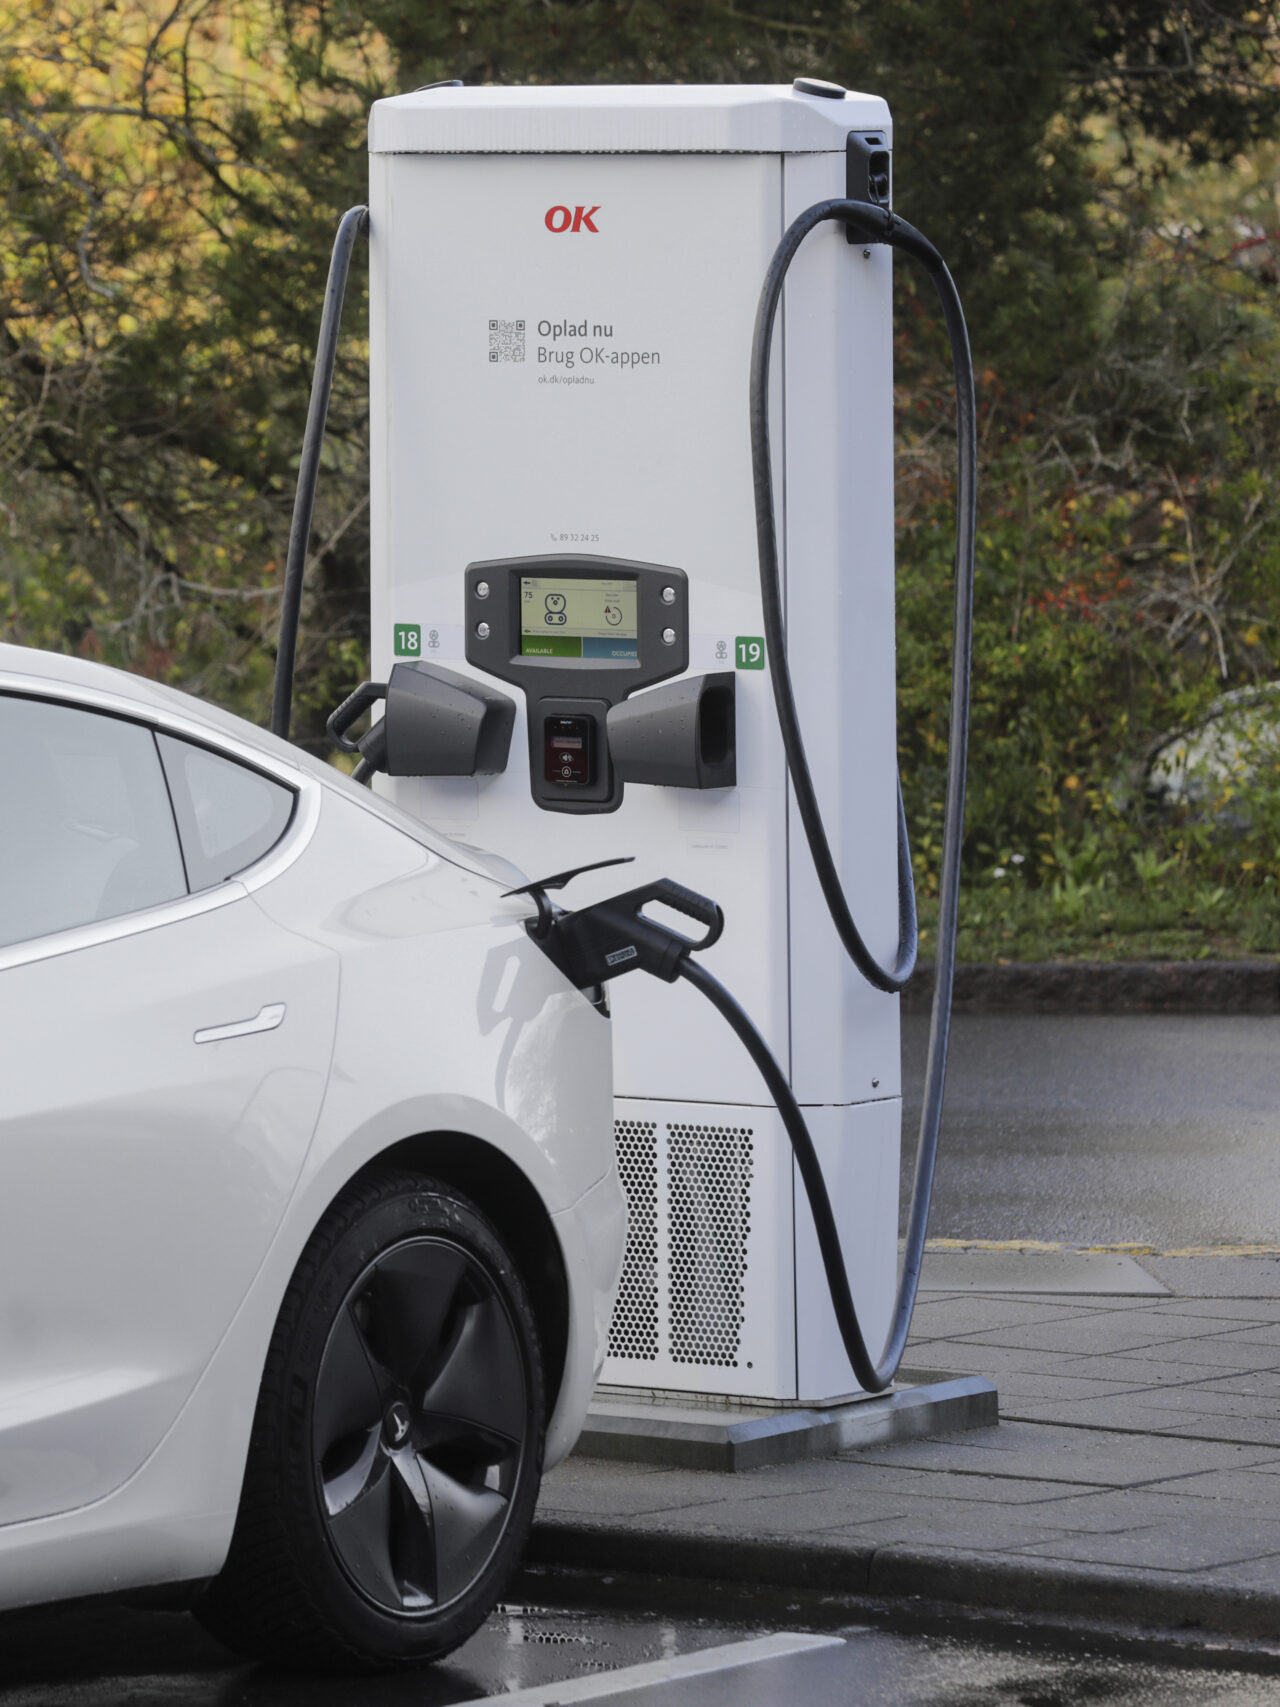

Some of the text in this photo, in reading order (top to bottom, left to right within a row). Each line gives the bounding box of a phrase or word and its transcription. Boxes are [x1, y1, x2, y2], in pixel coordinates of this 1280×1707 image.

[545, 205, 601, 233] OK
[538, 320, 613, 341] Oplad nu
[538, 347, 660, 368] Brug OK-appen
[538, 375, 595, 385] ok.dk/opladnu
[560, 533, 568, 541] 89
[524, 591, 533, 599] 75
[398, 631, 418, 650] 18
[739, 643, 761, 663] 19
